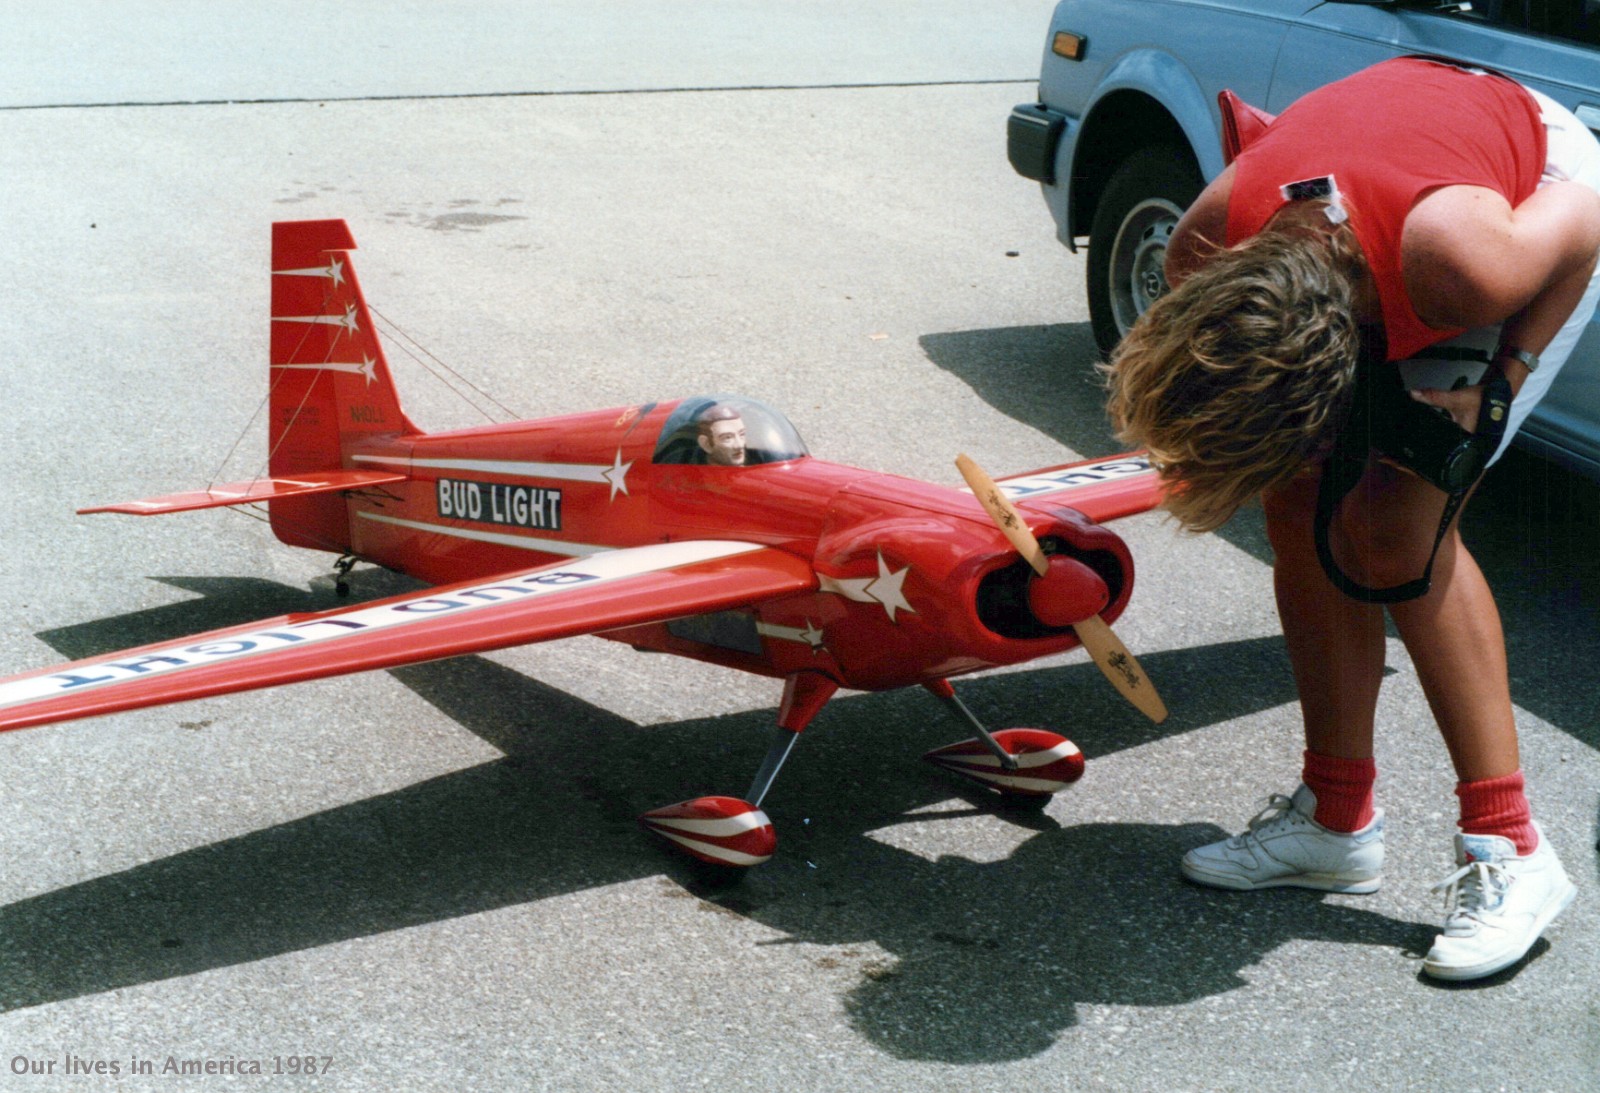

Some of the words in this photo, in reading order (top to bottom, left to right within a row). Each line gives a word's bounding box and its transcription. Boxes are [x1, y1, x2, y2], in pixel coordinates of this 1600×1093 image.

[1002, 462, 1149, 495] GHT
[439, 479, 482, 519] BUD
[491, 485, 561, 529] LIGHT
[391, 572, 601, 613] BUD
[50, 620, 368, 689] LIGHT
